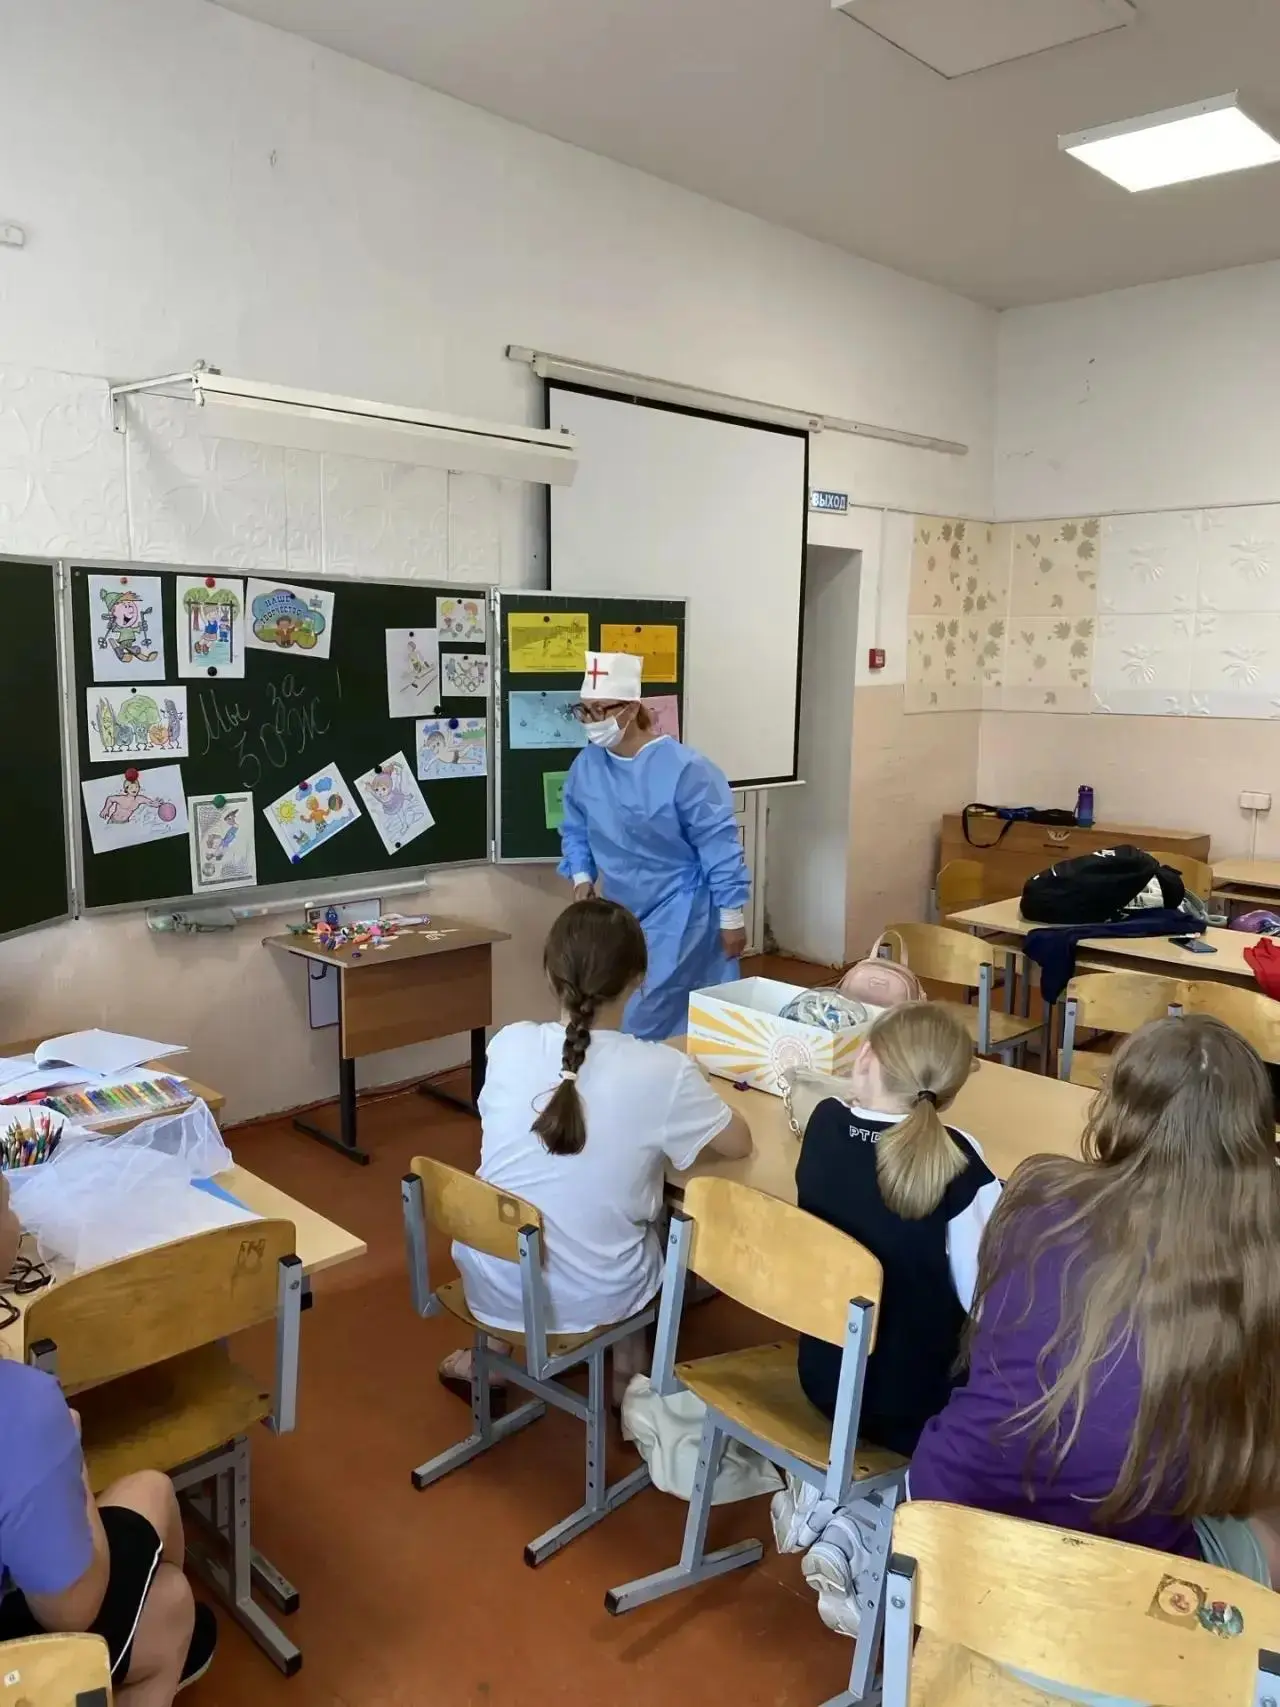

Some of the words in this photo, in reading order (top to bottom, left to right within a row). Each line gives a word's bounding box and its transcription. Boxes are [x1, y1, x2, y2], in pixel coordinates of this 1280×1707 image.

[812, 492, 846, 510] ВЫХОД
[264, 595, 291, 607] НАШЕ
[198, 689, 251, 756] Мы
